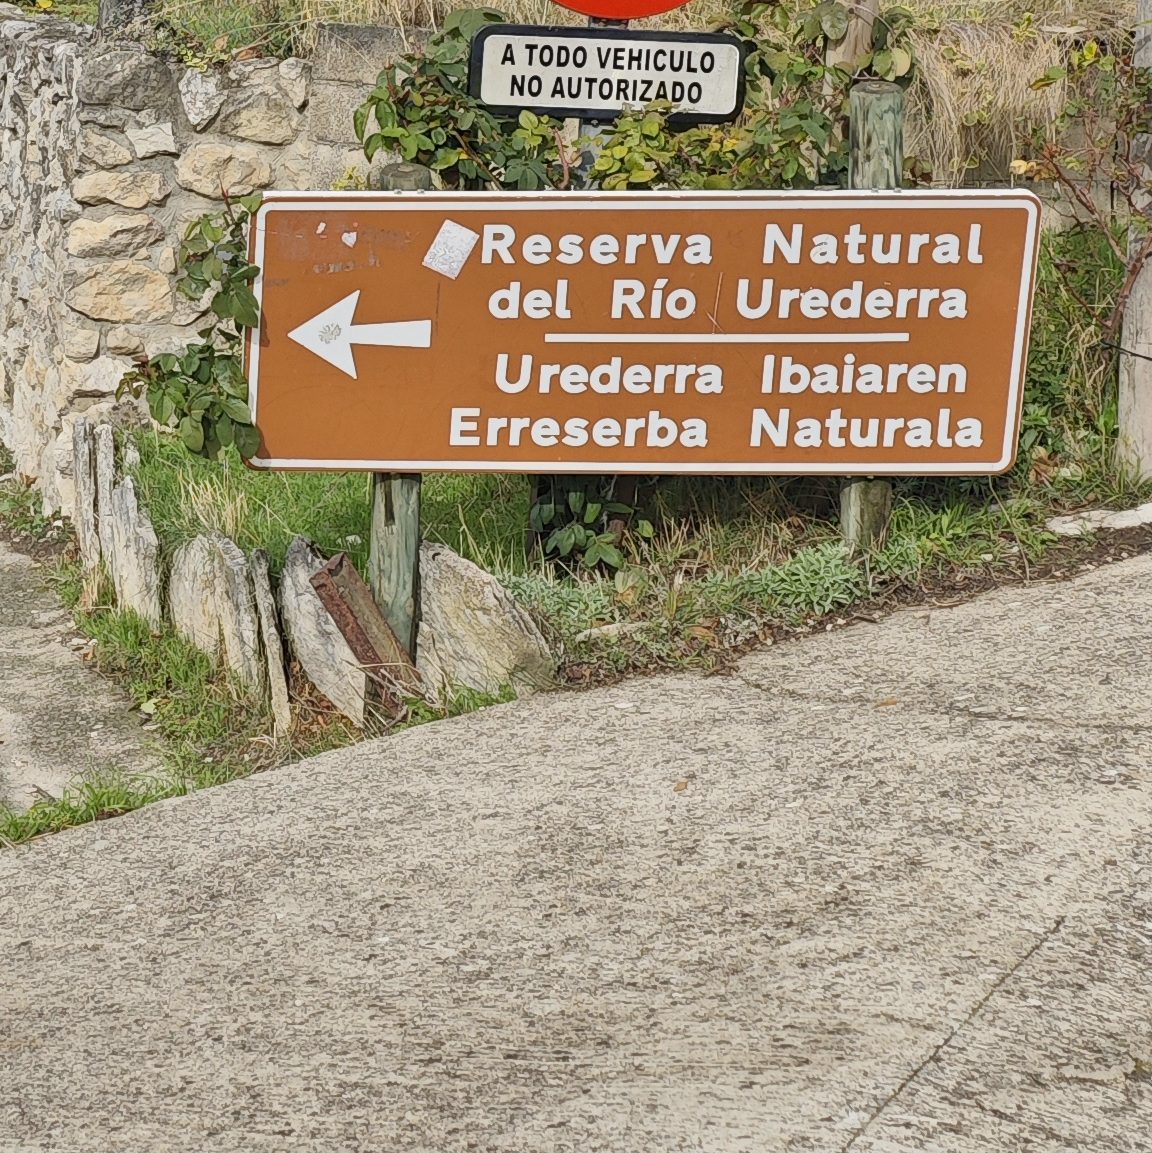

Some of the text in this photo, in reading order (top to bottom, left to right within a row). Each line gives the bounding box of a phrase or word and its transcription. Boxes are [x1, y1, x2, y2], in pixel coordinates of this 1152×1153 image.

[500, 43, 716, 74] A TODO VEHICULO
[509, 74, 703, 104] NO AUTORIZADO
[481, 223, 983, 265] Reserva Natural
[488, 278, 968, 320] del Río Urederra
[495, 353, 967, 394] Urederra Ibaiaren
[449, 407, 984, 448] Erreserba Naturala
